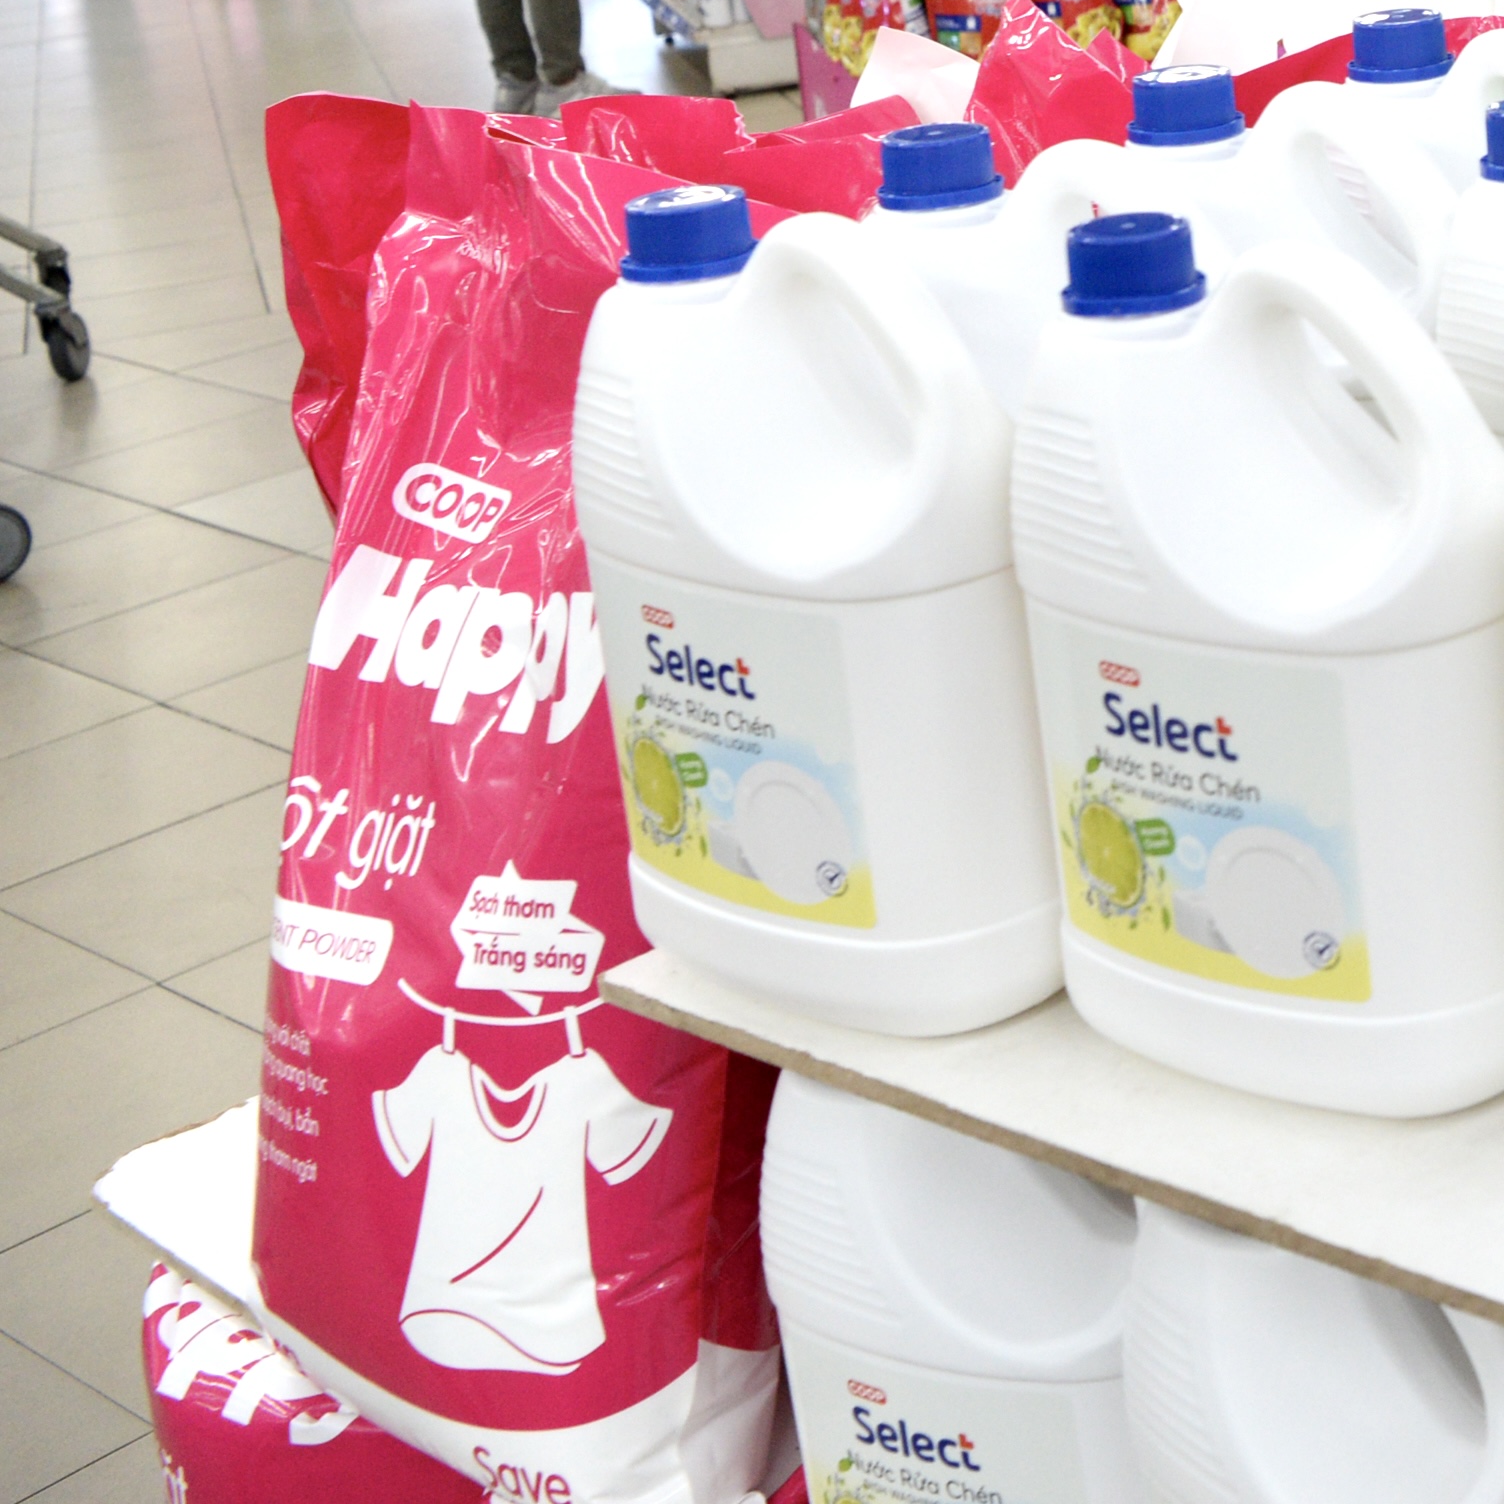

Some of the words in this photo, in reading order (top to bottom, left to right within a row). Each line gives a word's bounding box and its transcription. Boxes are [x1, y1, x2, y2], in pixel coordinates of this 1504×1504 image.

[404, 473, 504, 534] COOP
[309, 544, 606, 744] Happy
[646, 634, 755, 700] Select
[686, 698, 722, 728] Rửa
[724, 709, 776, 739] Chén
[1104, 692, 1239, 763] Select
[1151, 762, 1194, 792] Rửa
[1199, 772, 1262, 804] Chén
[280, 775, 349, 859] ột
[335, 799, 436, 890] giặt
[469, 889, 499, 919] Sạch
[502, 895, 555, 919] thơm
[298, 926, 377, 965] POWDER
[473, 936, 527, 973] Trắng
[534, 944, 587, 976] sáng
[852, 1406, 981, 1472] Select
[472, 1445, 572, 1499] Save
